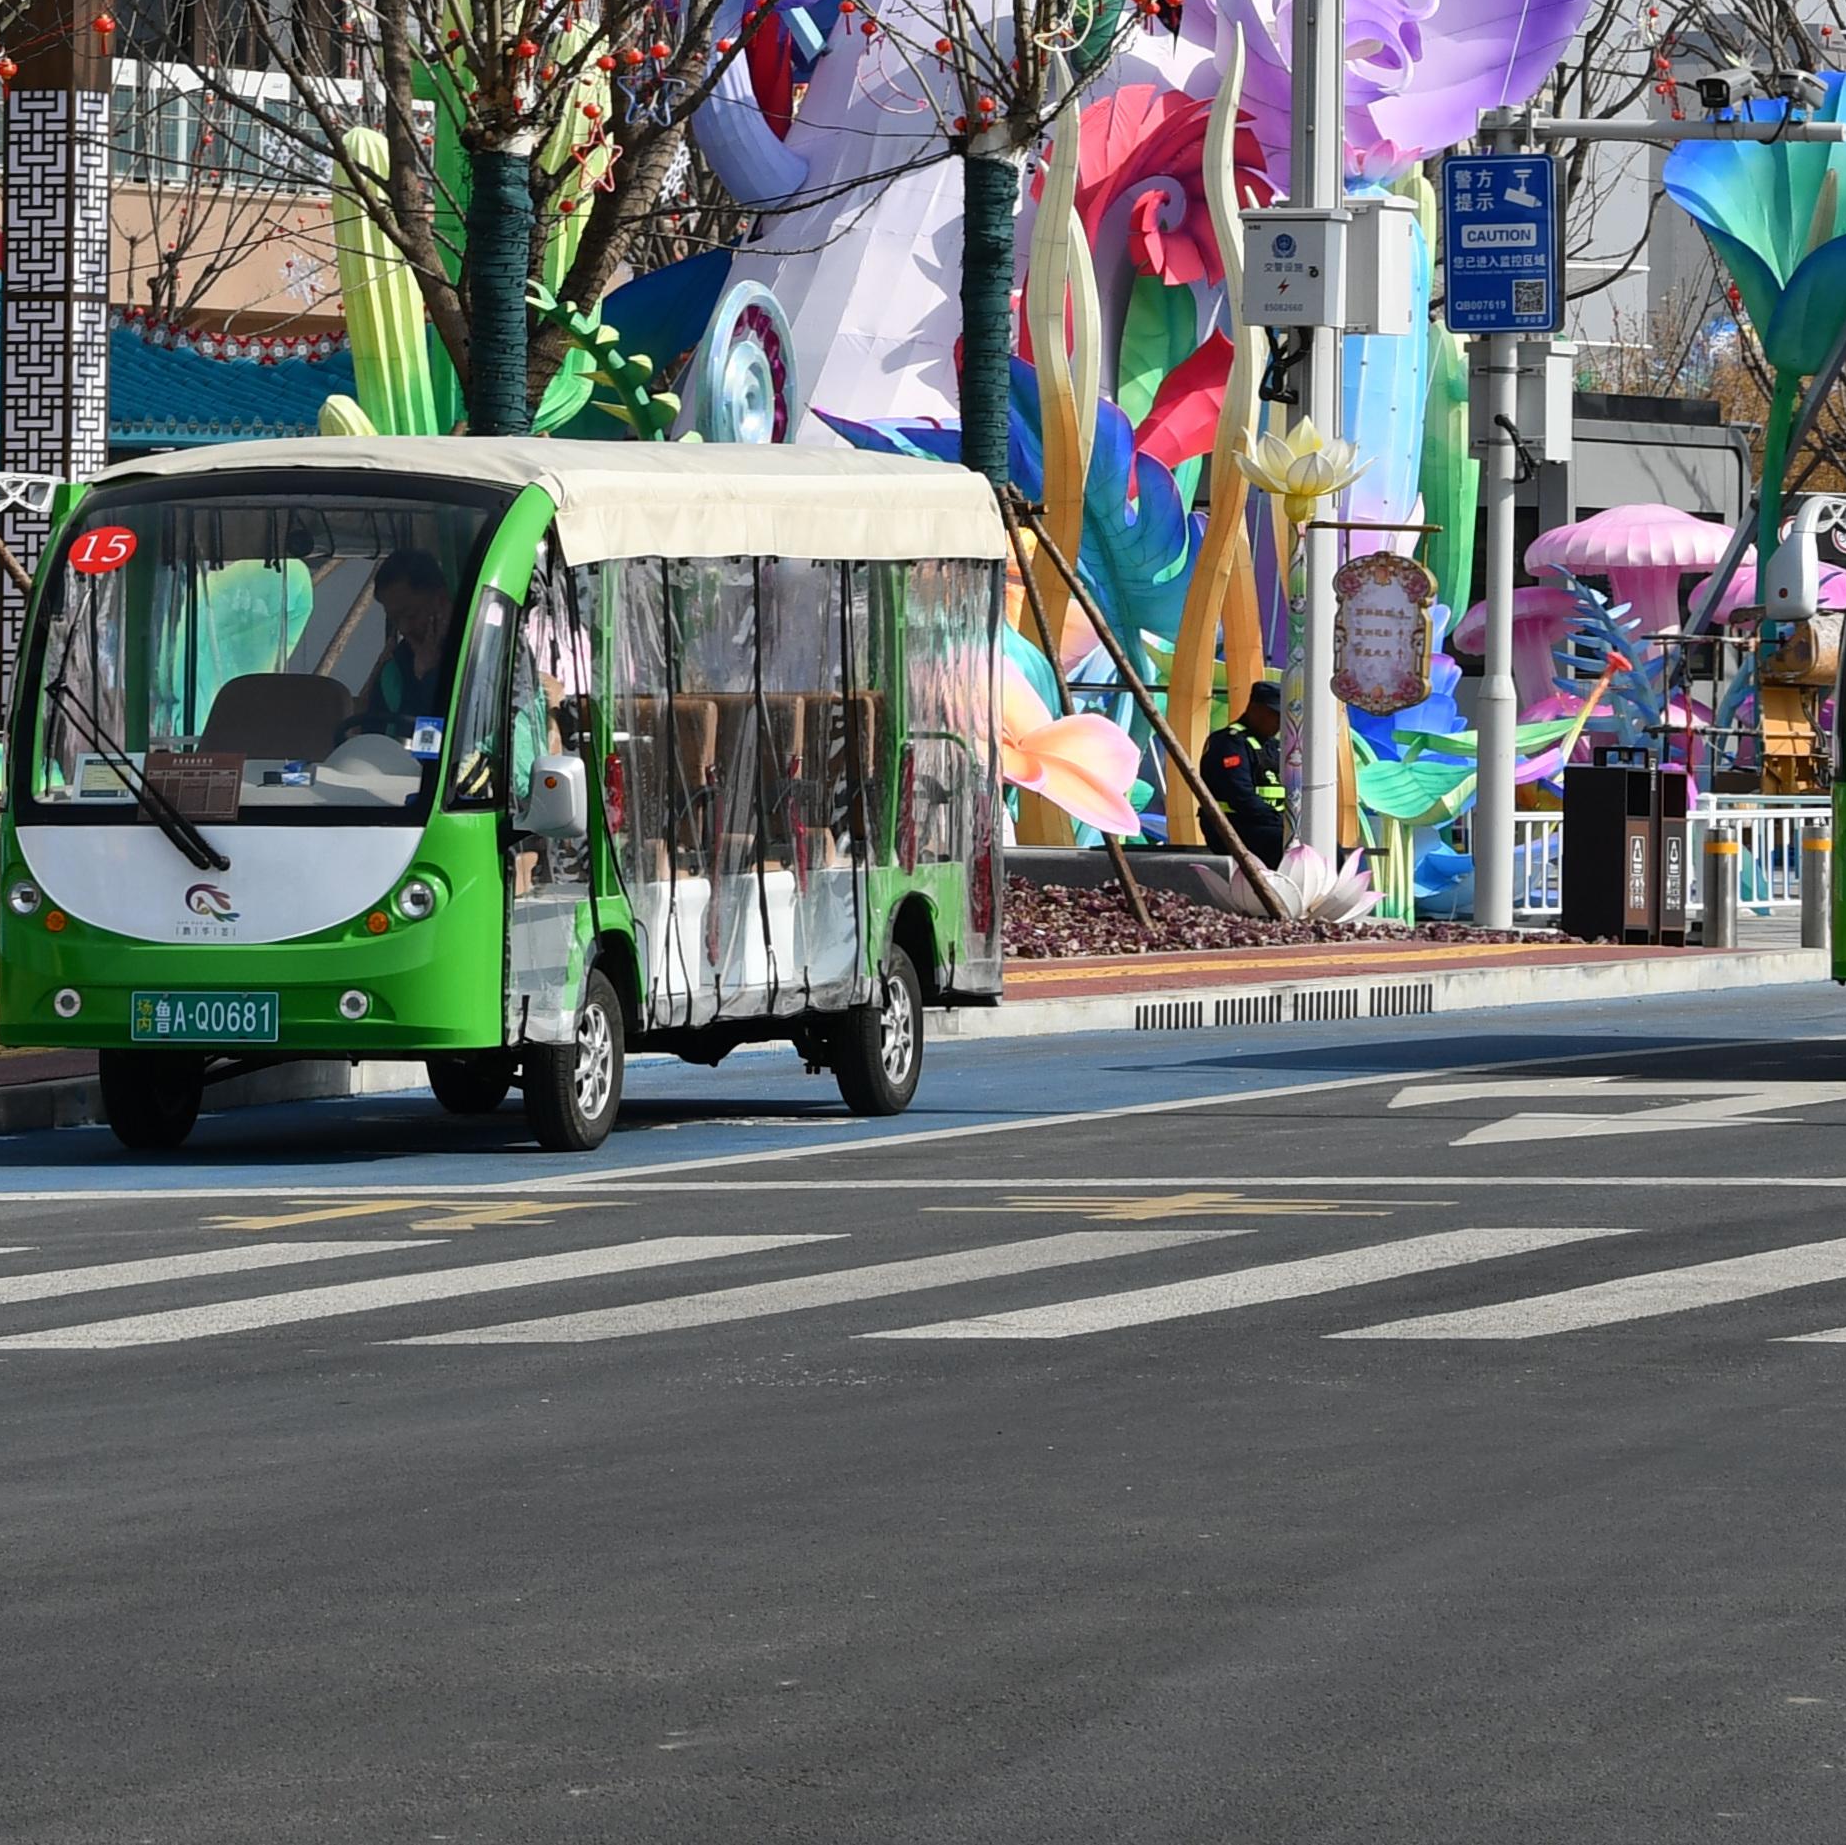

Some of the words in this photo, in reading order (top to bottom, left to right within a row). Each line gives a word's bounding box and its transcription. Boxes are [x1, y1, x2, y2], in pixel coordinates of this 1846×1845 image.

[1455, 169, 1493, 189] 警方
[1455, 193, 1494, 212] 提示
[1466, 229, 1531, 243] CAUTION
[1453, 254, 1547, 269] 您已进入监控区域
[76, 534, 132, 563] 15
[136, 998, 153, 1033] 场内
